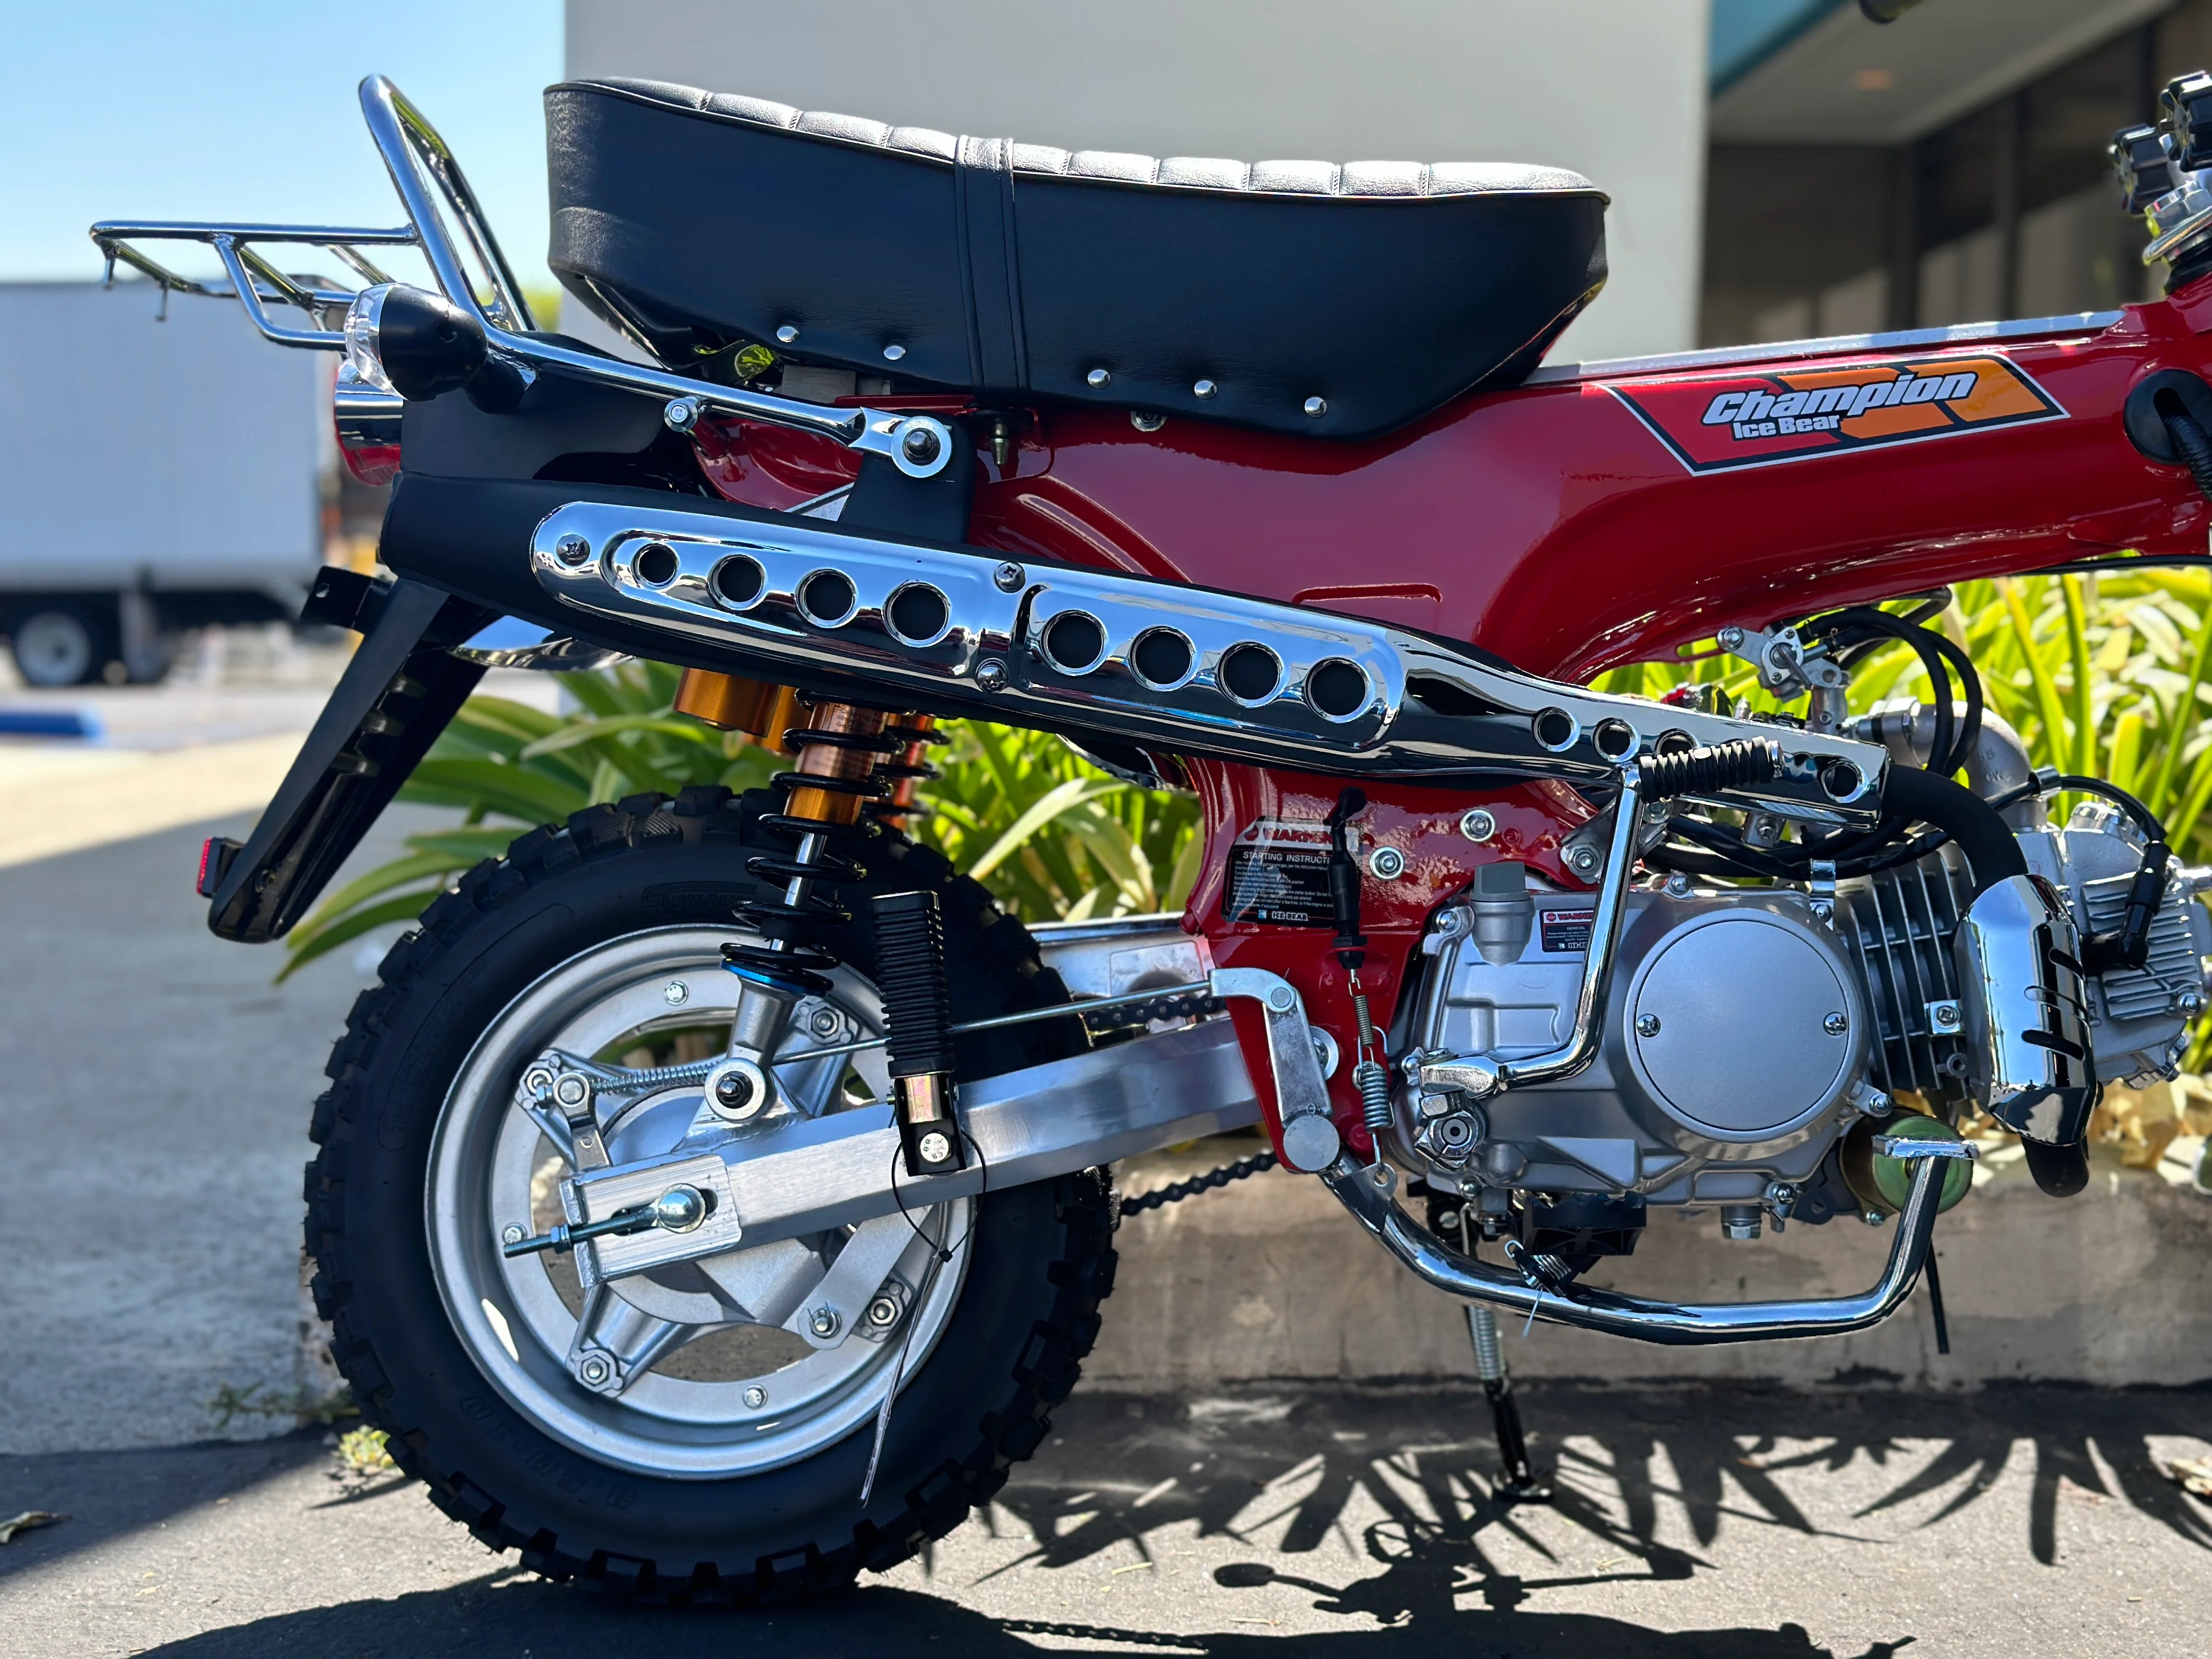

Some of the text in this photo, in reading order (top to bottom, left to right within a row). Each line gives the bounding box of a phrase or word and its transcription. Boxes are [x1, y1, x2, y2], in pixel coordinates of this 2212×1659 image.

[1702, 373, 1976, 424] Champion
[1733, 415, 1841, 439] Ice Bear
[1243, 851, 1283, 861] STARTING
[1286, 854, 1329, 864] INSTRUCTI
[1272, 911, 1308, 921] ICE BEAR
[1557, 912, 1593, 921] WARNI
